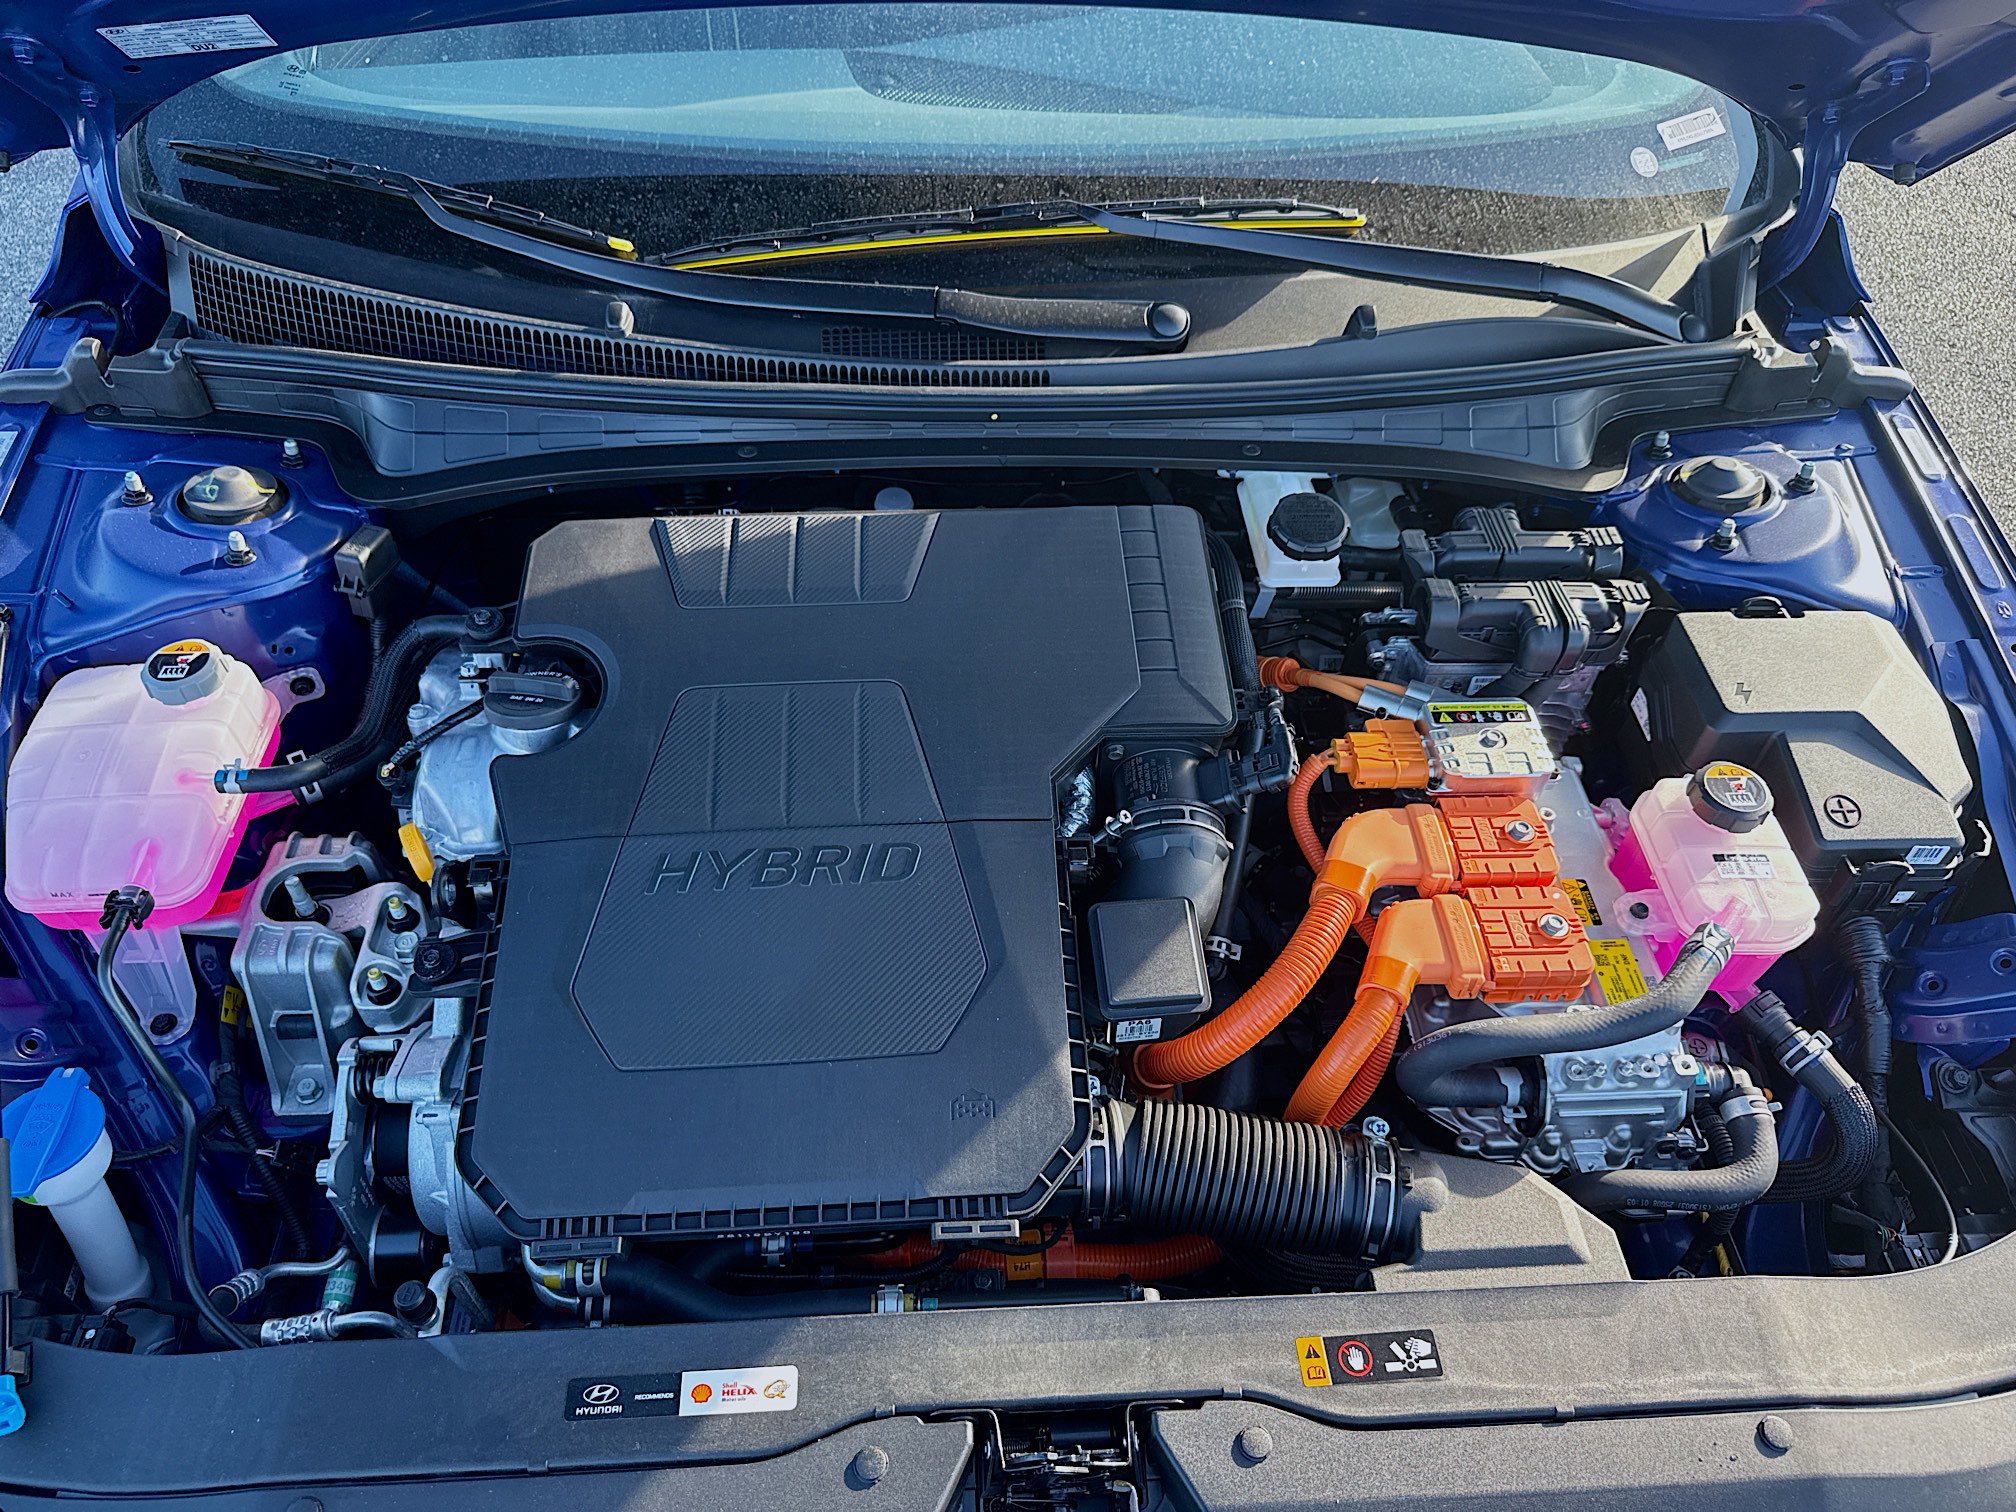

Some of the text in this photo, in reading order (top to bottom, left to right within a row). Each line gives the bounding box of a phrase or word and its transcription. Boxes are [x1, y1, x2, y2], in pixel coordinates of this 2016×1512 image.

[190, 43, 218, 51] DU2
[644, 841, 922, 895] HYBRID
[722, 1381, 738, 1389] Shell
[634, 1392, 674, 1400] RECOMMENDS
[721, 1387, 757, 1397] HELIX
[575, 1405, 623, 1416] HYUNDAI
